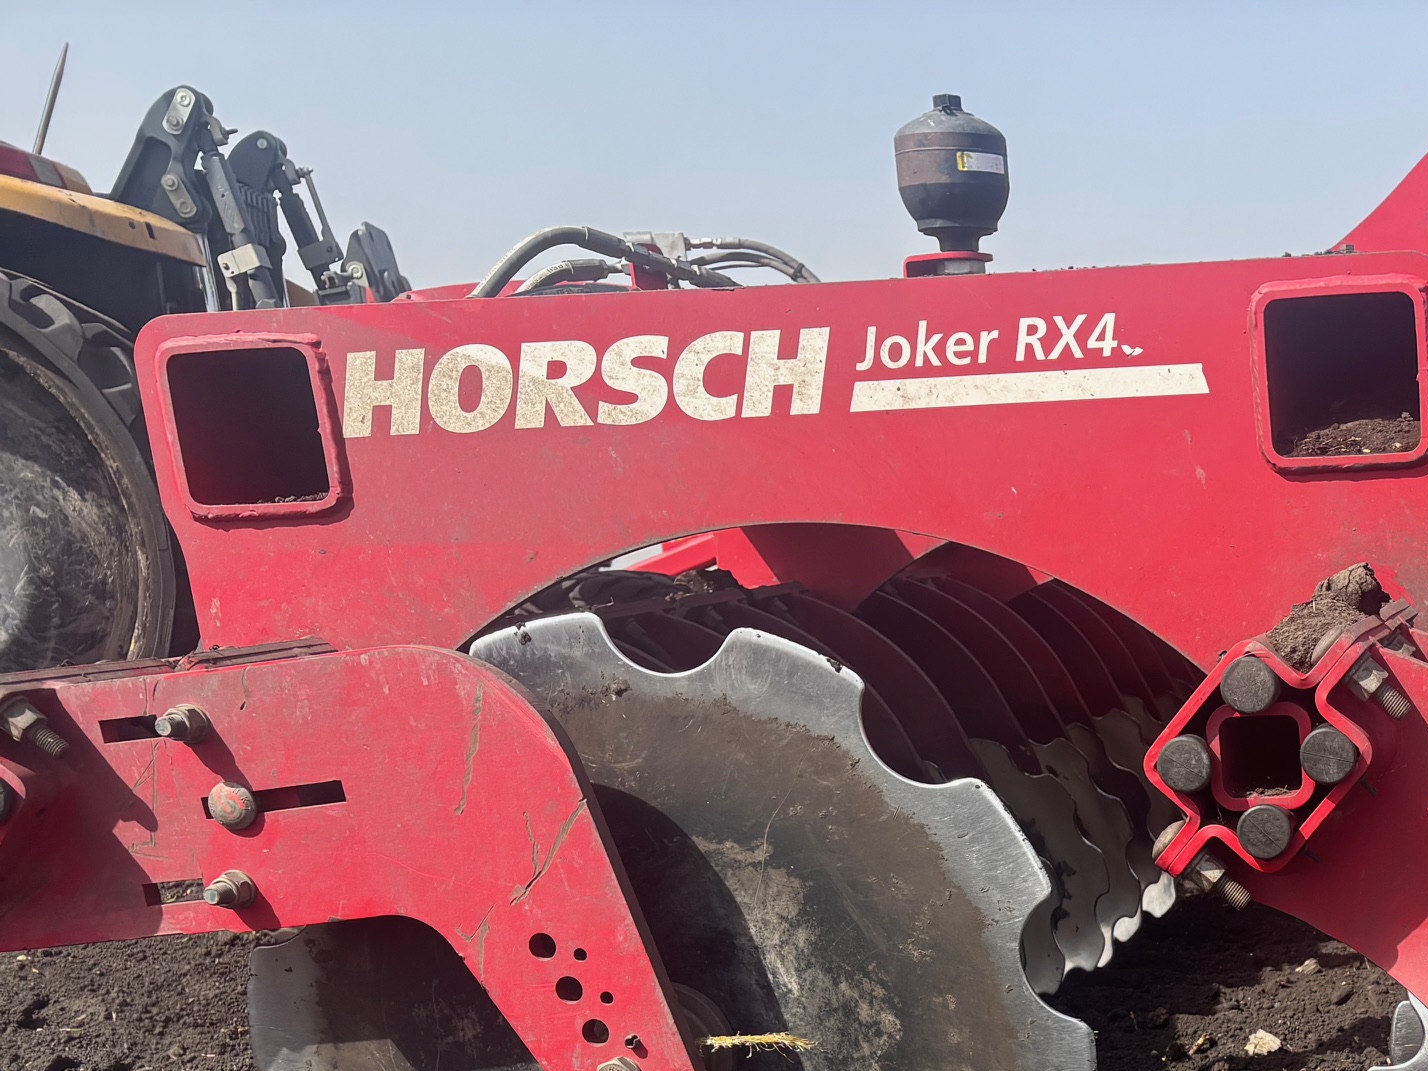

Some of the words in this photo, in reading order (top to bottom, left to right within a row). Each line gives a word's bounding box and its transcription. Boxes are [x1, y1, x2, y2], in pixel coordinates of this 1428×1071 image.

[343, 327, 830, 438] HORSCH
[856, 320, 998, 370] Joker
[1016, 313, 1143, 363] RX4
